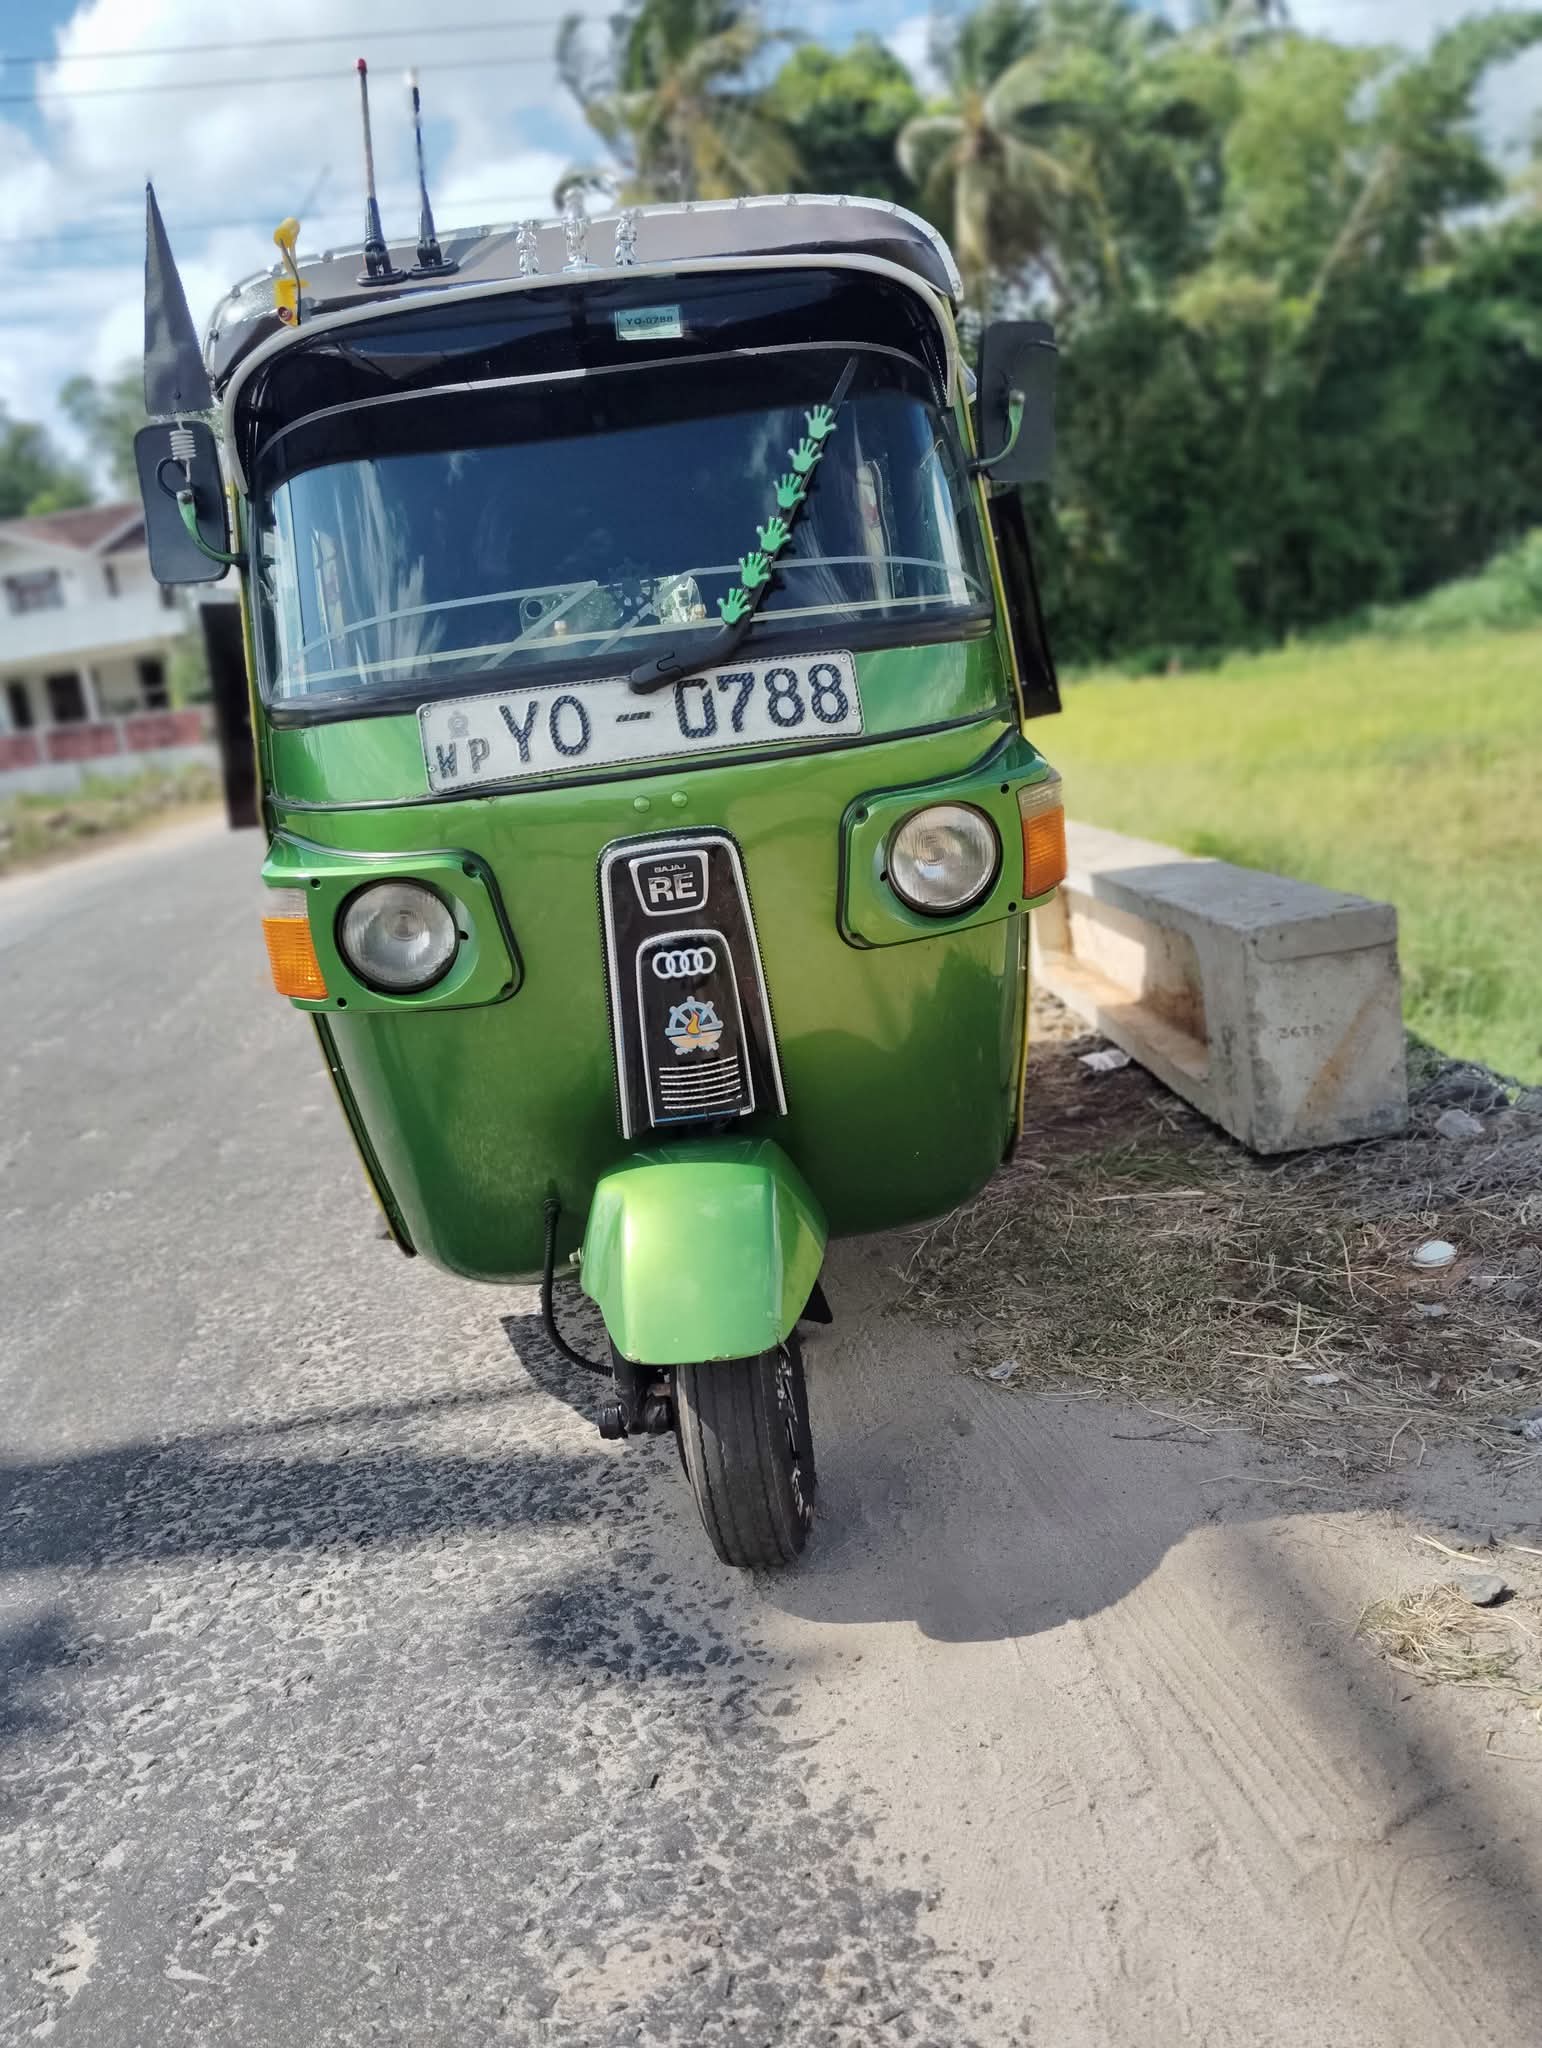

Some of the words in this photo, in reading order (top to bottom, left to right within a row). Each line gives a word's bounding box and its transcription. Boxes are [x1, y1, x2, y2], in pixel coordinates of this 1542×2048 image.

[672, 662, 850, 739] 0788
[654, 864, 686, 873] BAJAJ
[648, 871, 697, 903] RE
